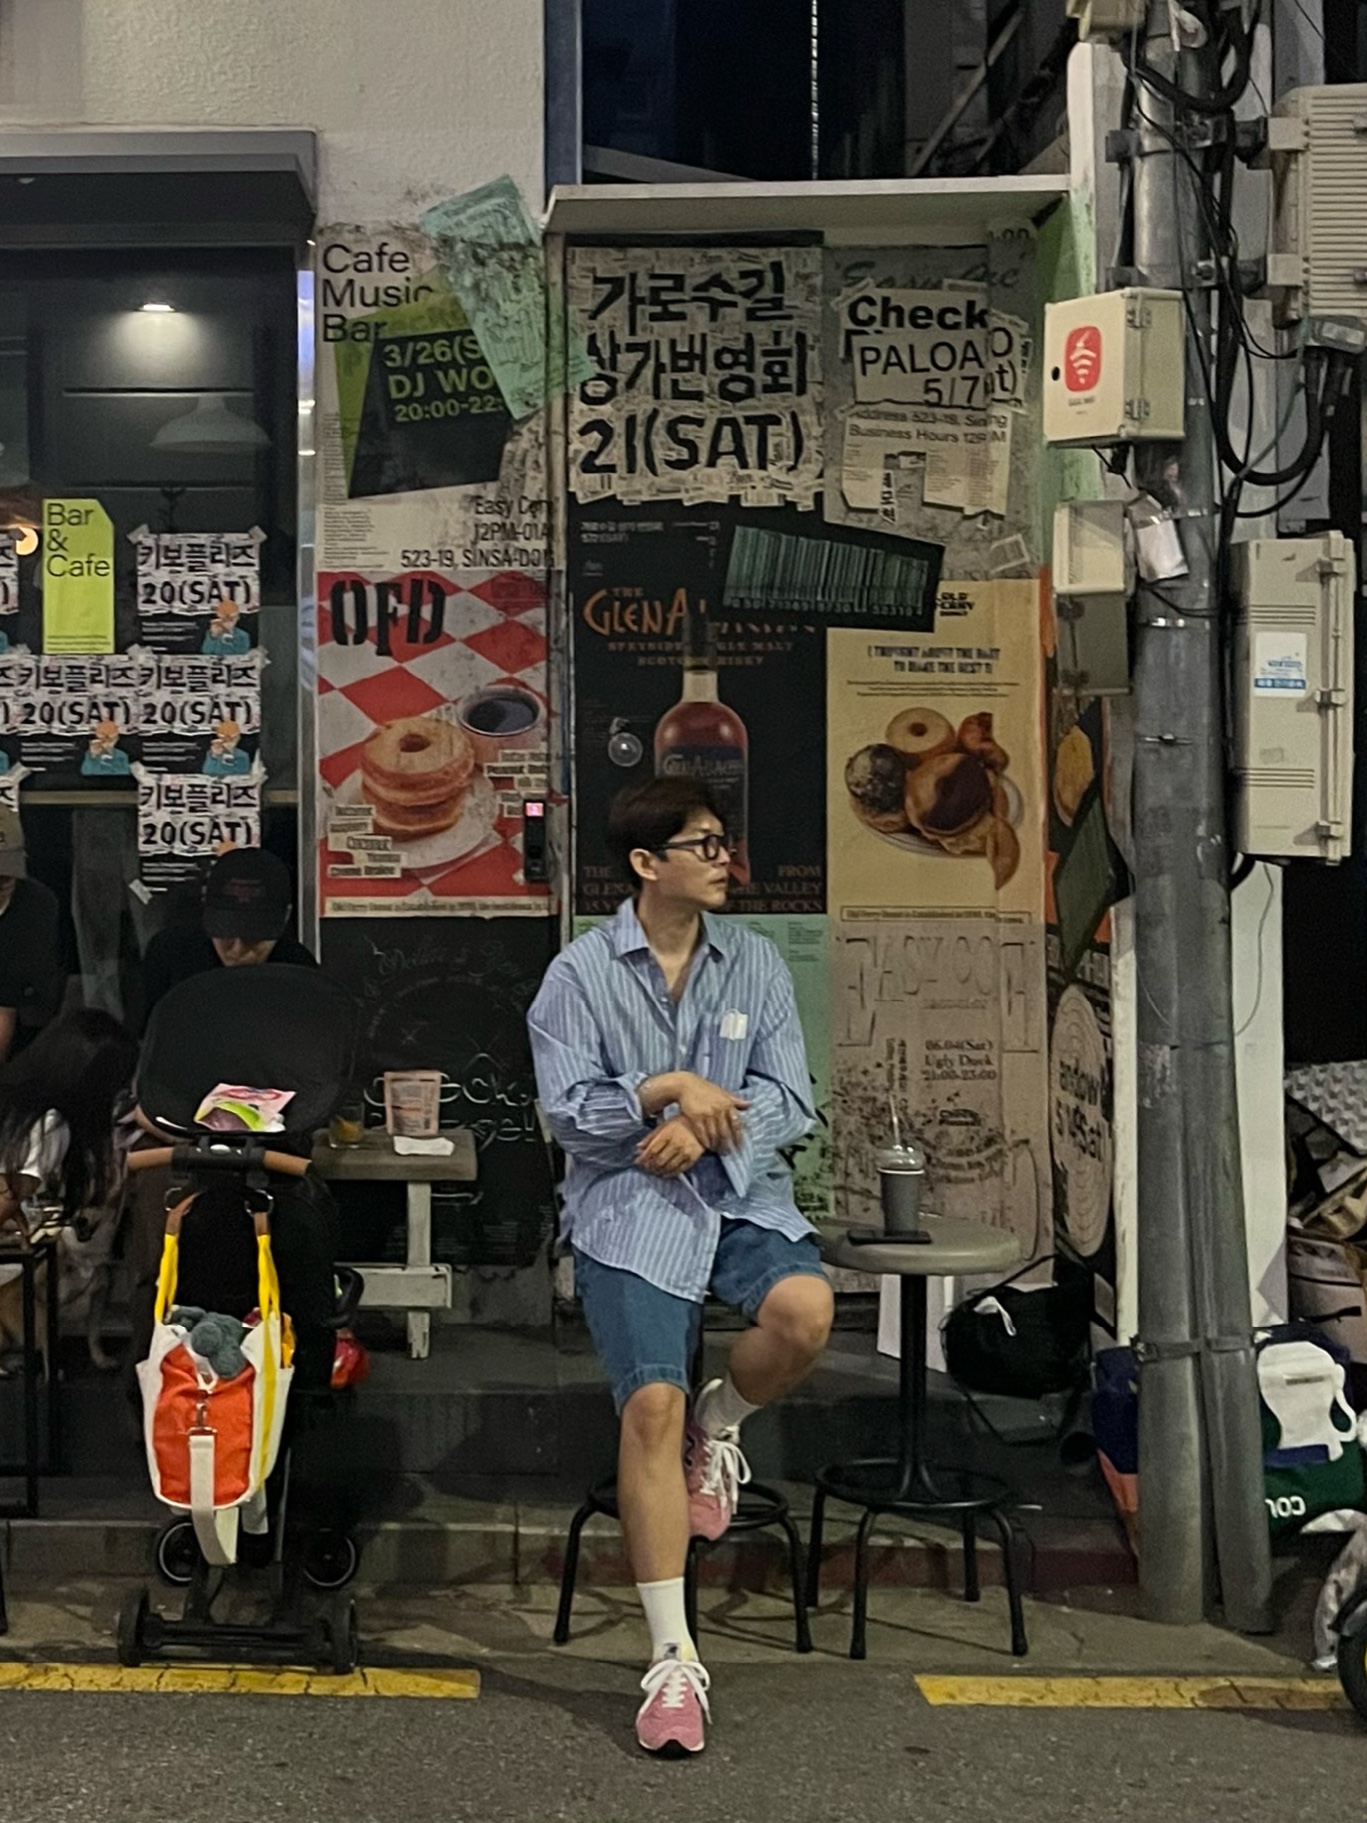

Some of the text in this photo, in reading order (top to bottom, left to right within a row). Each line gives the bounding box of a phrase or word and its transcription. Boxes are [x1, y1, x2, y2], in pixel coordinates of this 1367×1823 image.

[323, 242, 410, 273] Cafe
[588, 260, 794, 336] 가로수길
[848, 294, 989, 330] Check
[388, 365, 494, 400] DJ WO
[578, 407, 804, 477] 21(SAT)
[47, 502, 95, 526] Bar
[46, 527, 69, 552] &
[46, 552, 111, 577] Cafe
[139, 543, 259, 572] 키보플리즈
[142, 579, 252, 607] 20(SAT)
[330, 578, 447, 656] OFD
[20, 664, 139, 692] 키보플리즈
[140, 664, 259, 692] 키보플리즈
[22, 700, 131, 727] 20(SAT)
[142, 700, 252, 727] 20(SAT)
[140, 784, 259, 814] 키보플리즈
[142, 820, 252, 847] 20(SAT)
